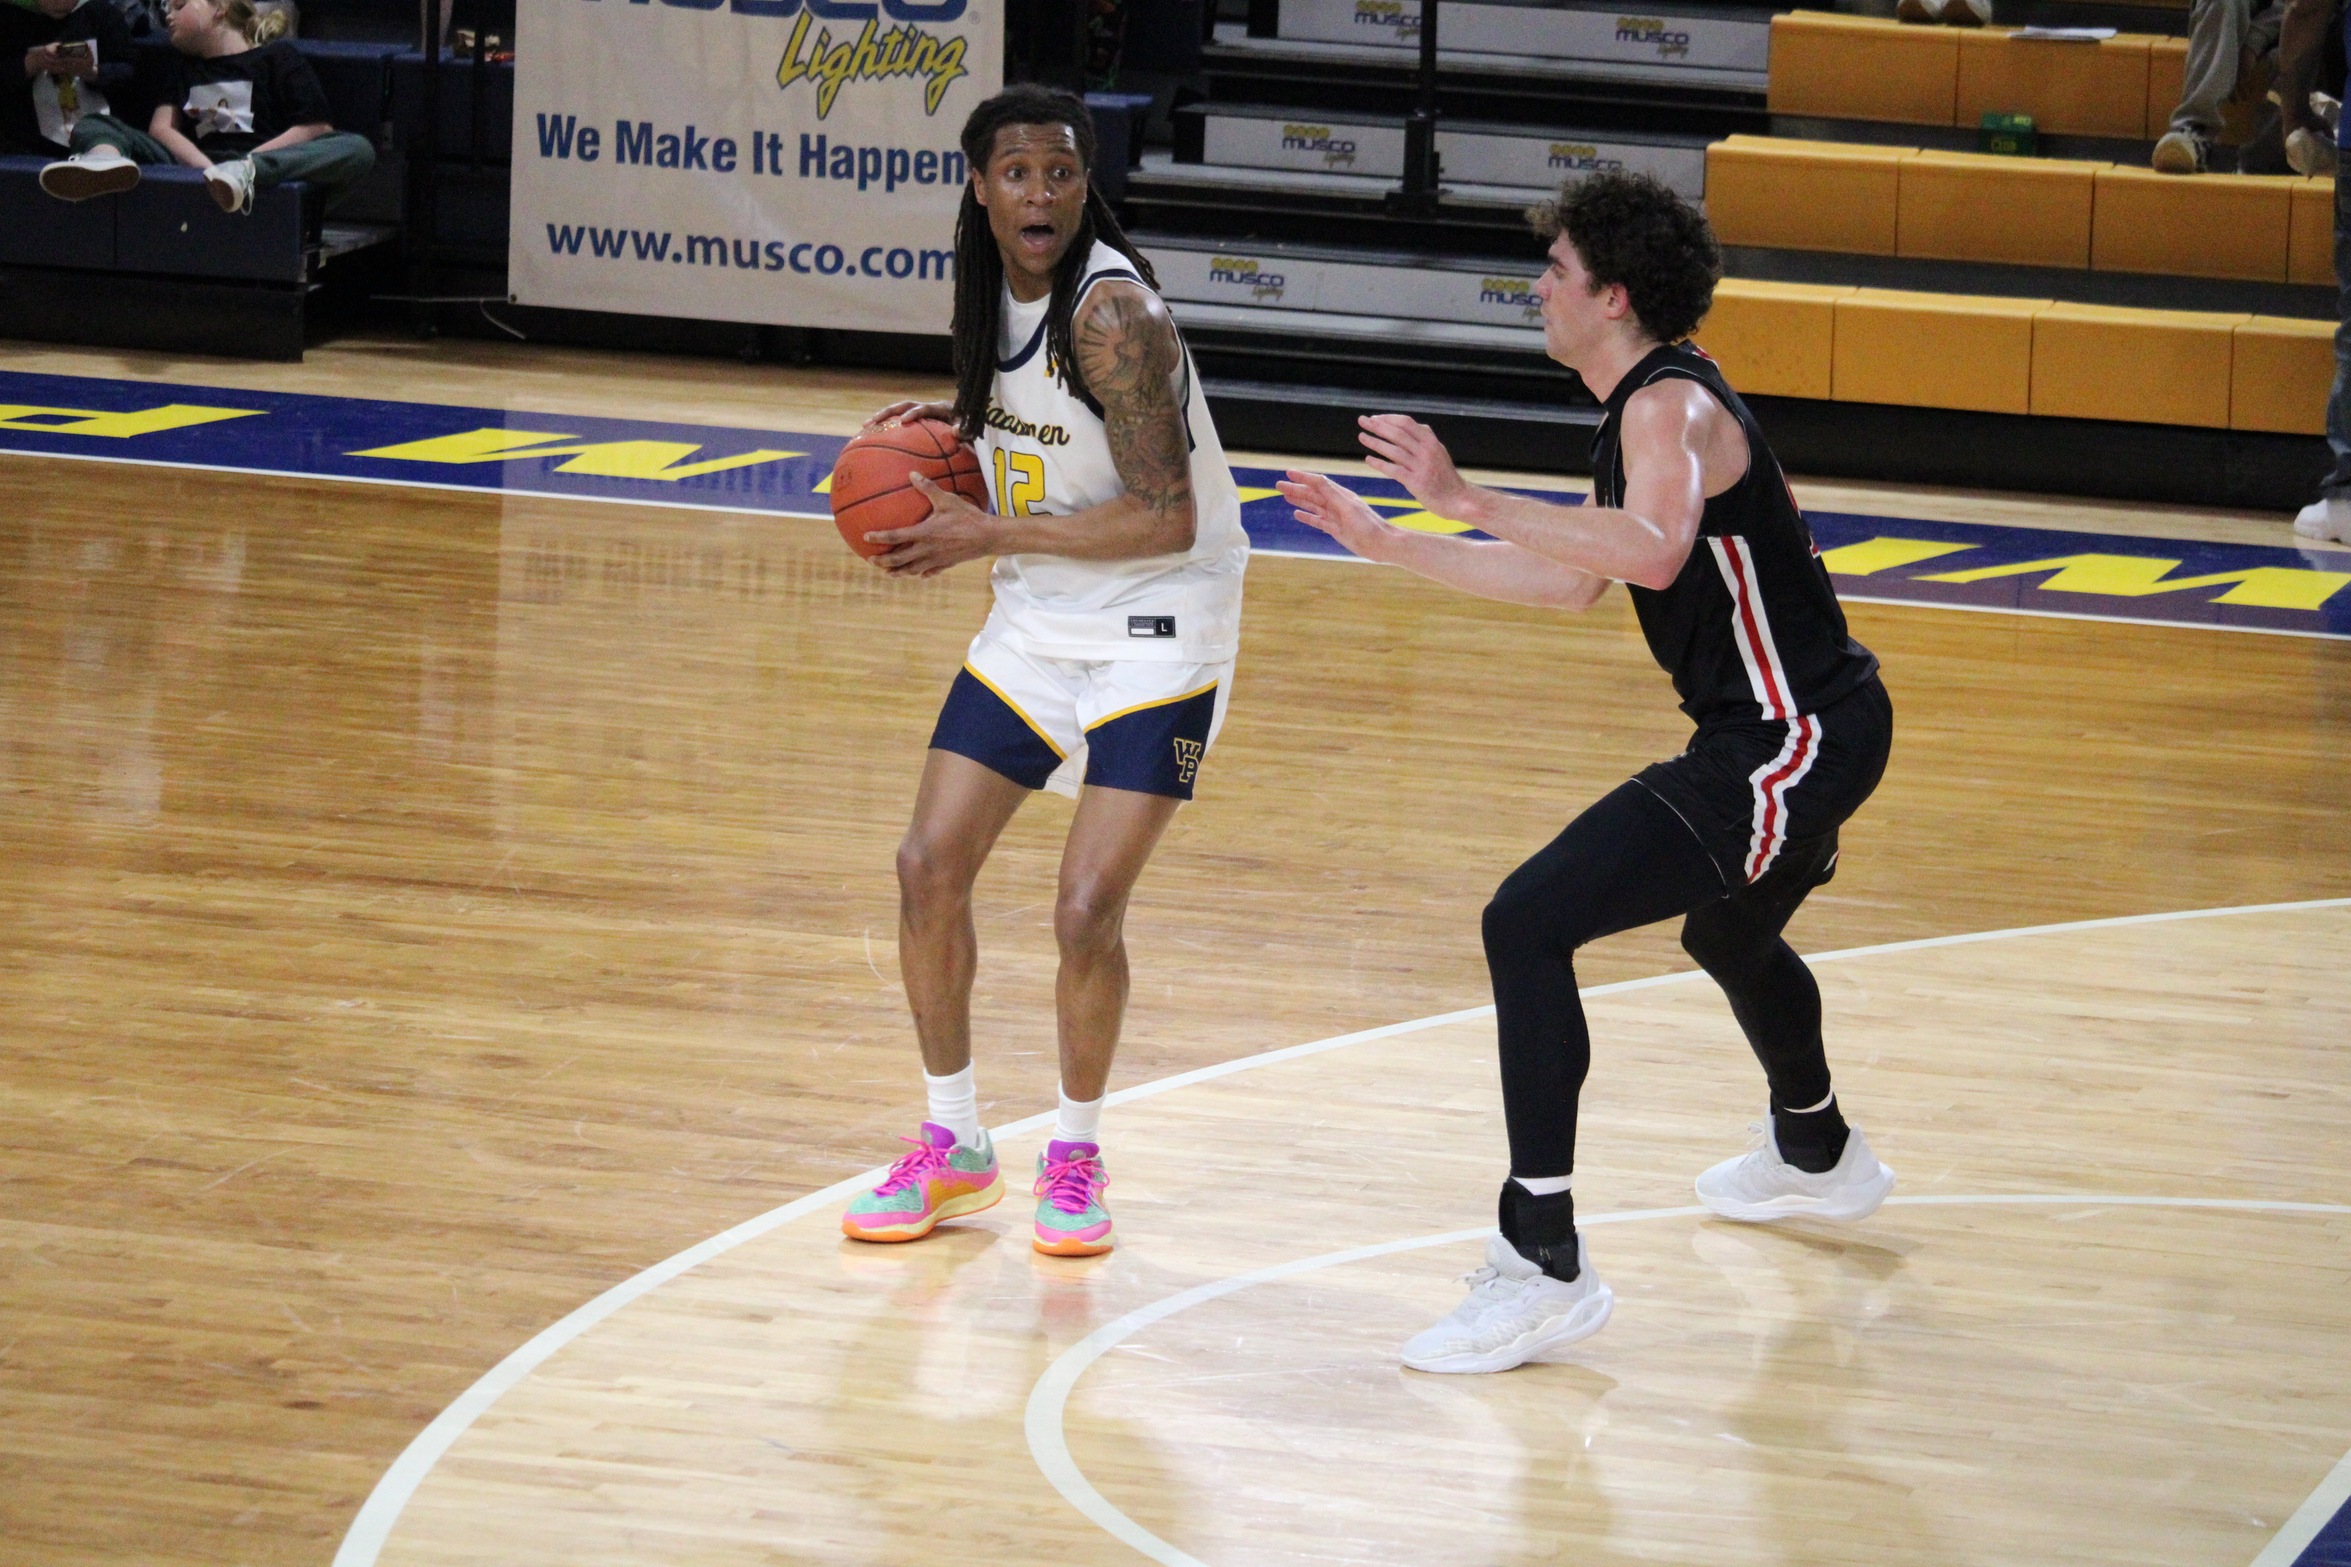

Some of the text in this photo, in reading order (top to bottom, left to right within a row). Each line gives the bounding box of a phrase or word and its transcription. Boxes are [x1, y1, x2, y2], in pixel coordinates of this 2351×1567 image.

[777, 8, 968, 121] Lighting
[537, 113, 965, 193] We Make It Happen
[546, 223, 957, 281] www.musco.com
[993, 446, 1053, 517] 12
